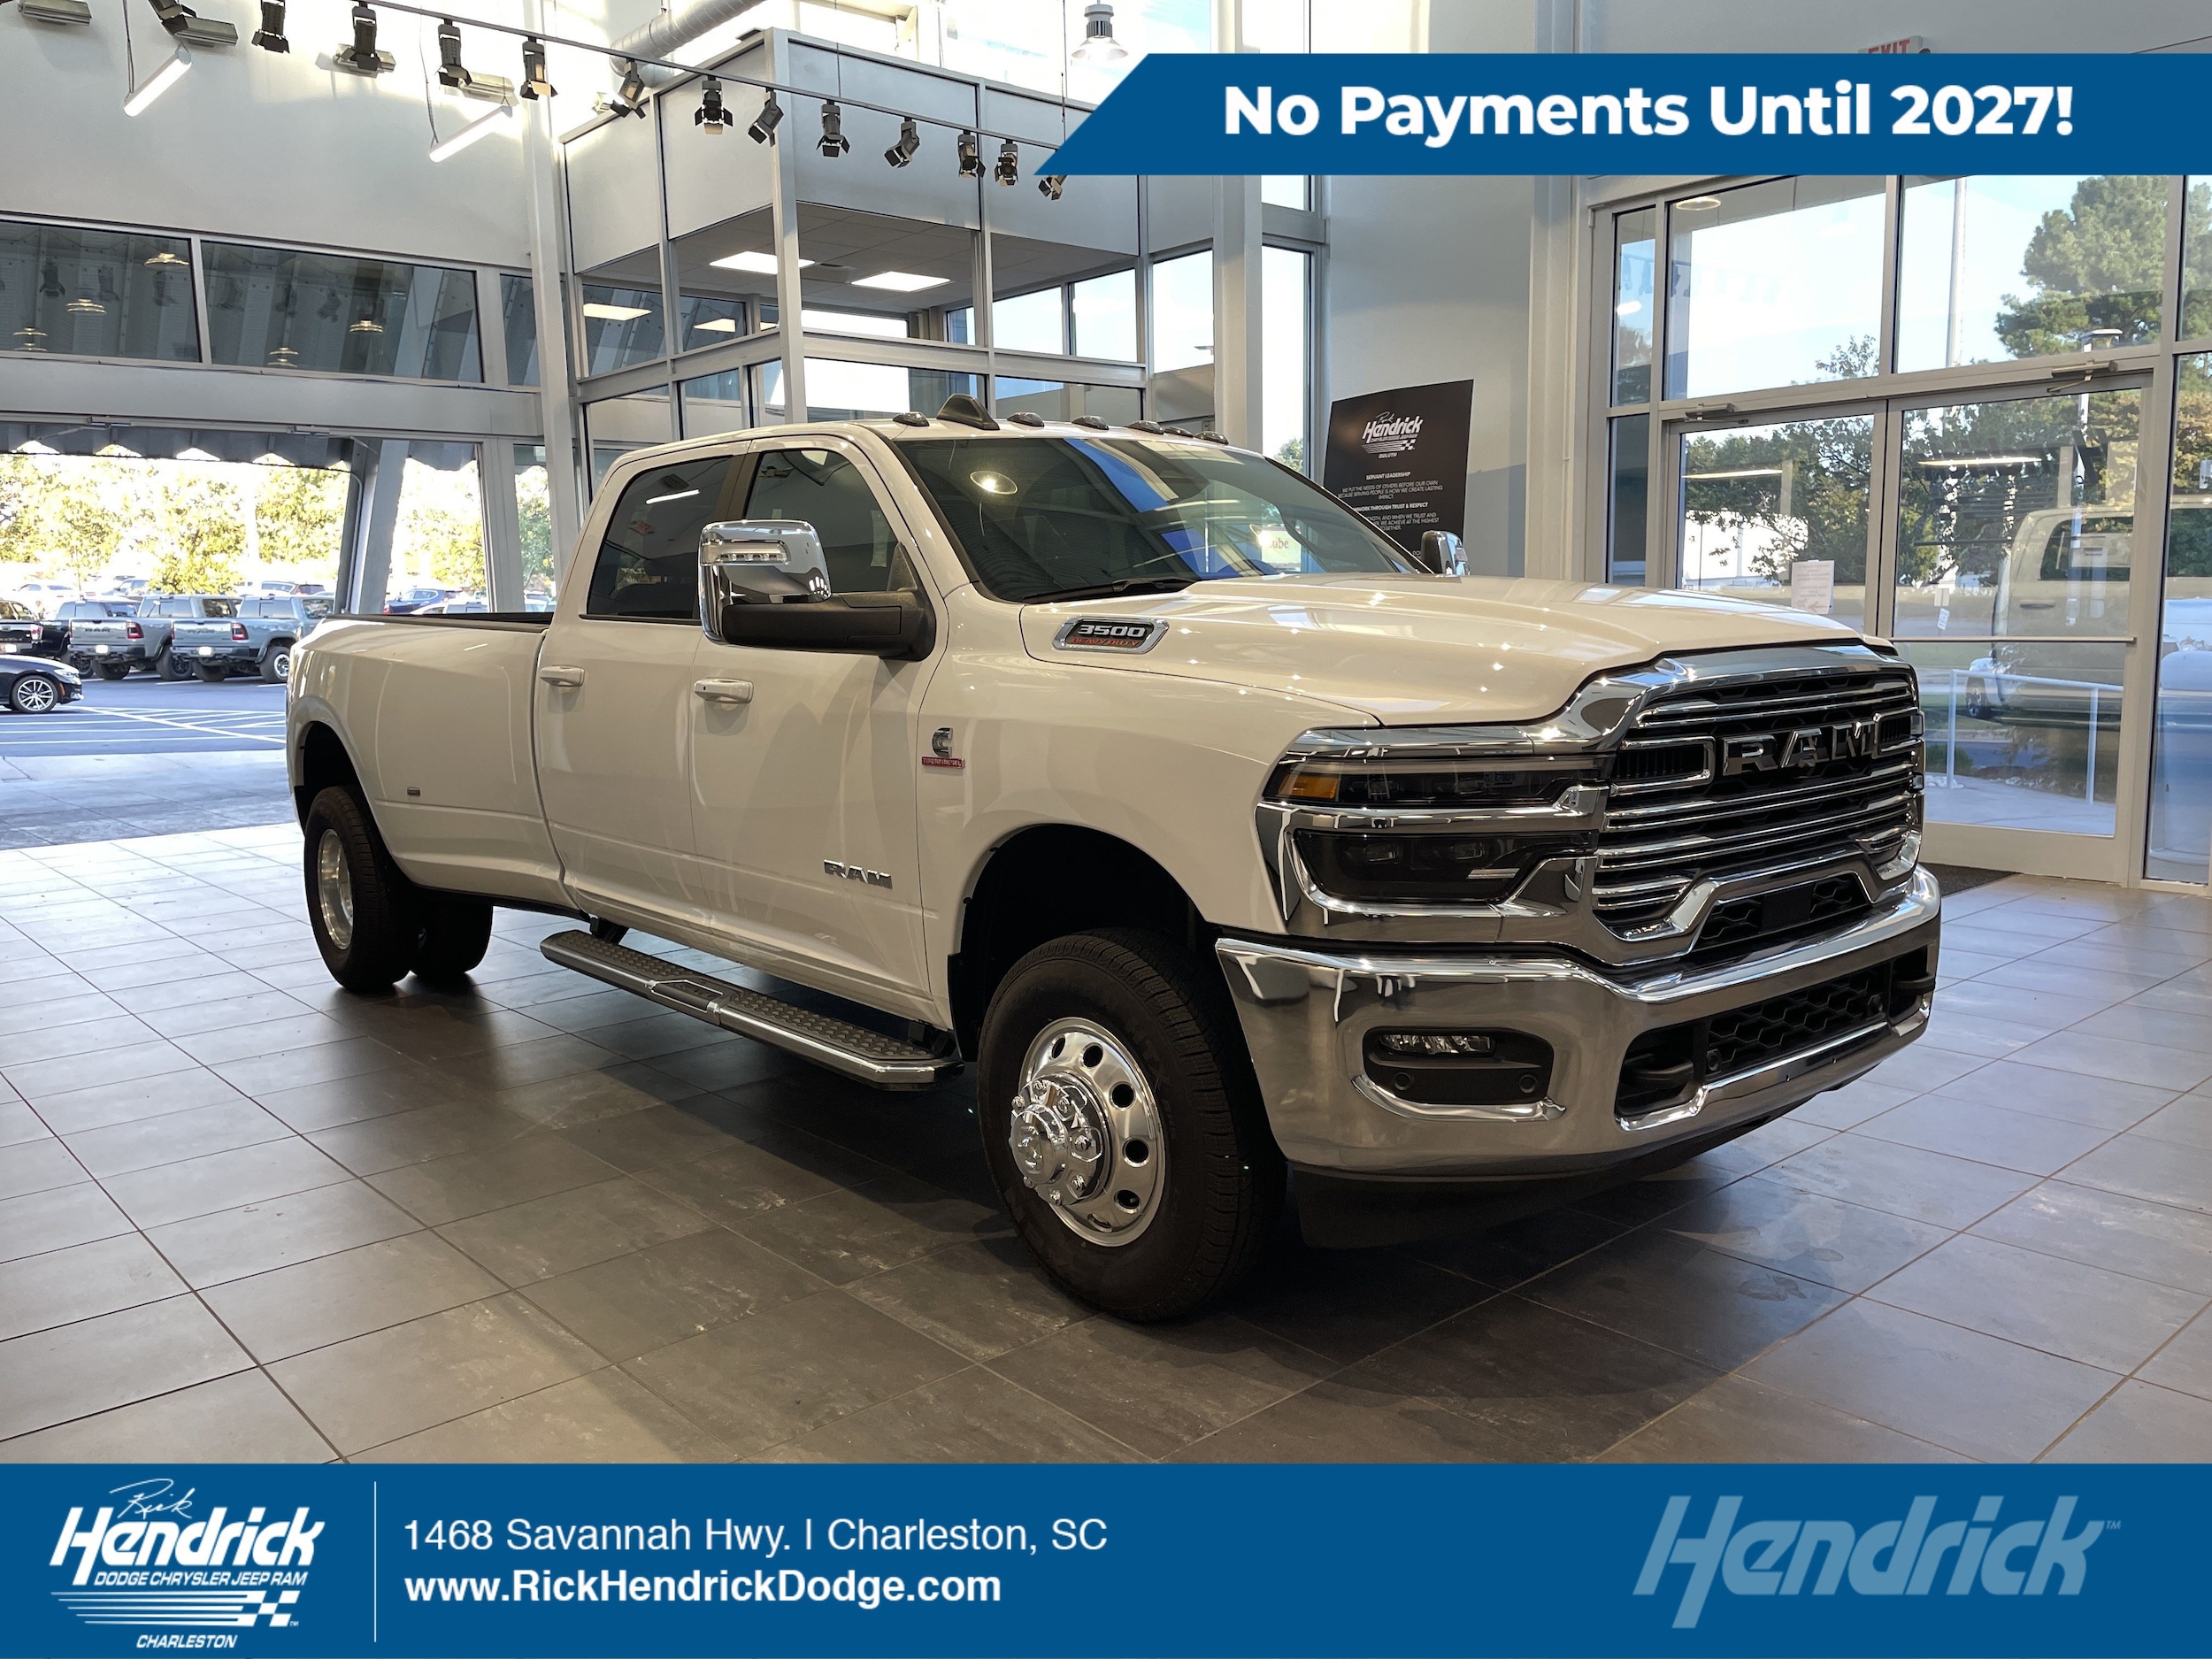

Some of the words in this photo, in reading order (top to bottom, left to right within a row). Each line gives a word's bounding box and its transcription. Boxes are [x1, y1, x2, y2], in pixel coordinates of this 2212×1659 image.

[1363, 416, 1423, 443] Hendrick
[1271, 538, 1289, 549] ube
[1078, 625, 1146, 637] 3500
[1723, 720, 1877, 776] RAM
[824, 859, 893, 889] RAM
